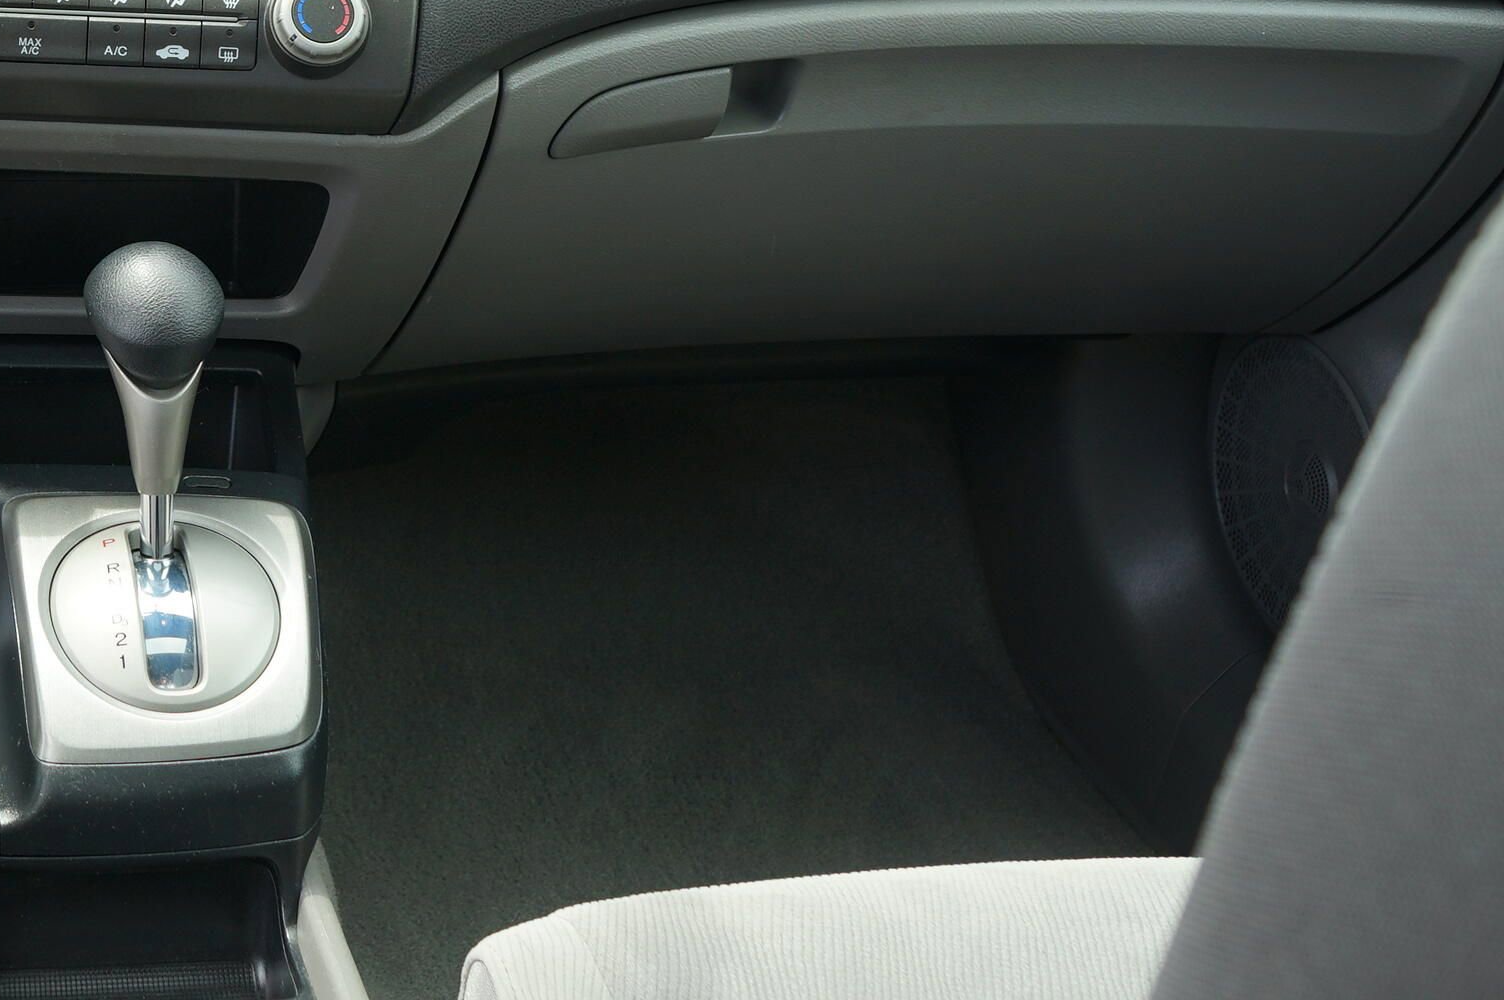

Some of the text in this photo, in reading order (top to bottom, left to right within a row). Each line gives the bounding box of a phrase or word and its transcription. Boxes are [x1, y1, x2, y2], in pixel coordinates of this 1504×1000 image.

[18, 37, 42, 47] MAX
[20, 46, 40, 55] A/C
[103, 46, 128, 57] A/C
[102, 538, 115, 547] P
[106, 563, 120, 574] R
[115, 632, 127, 647] 2
[119, 654, 126, 669] 1
